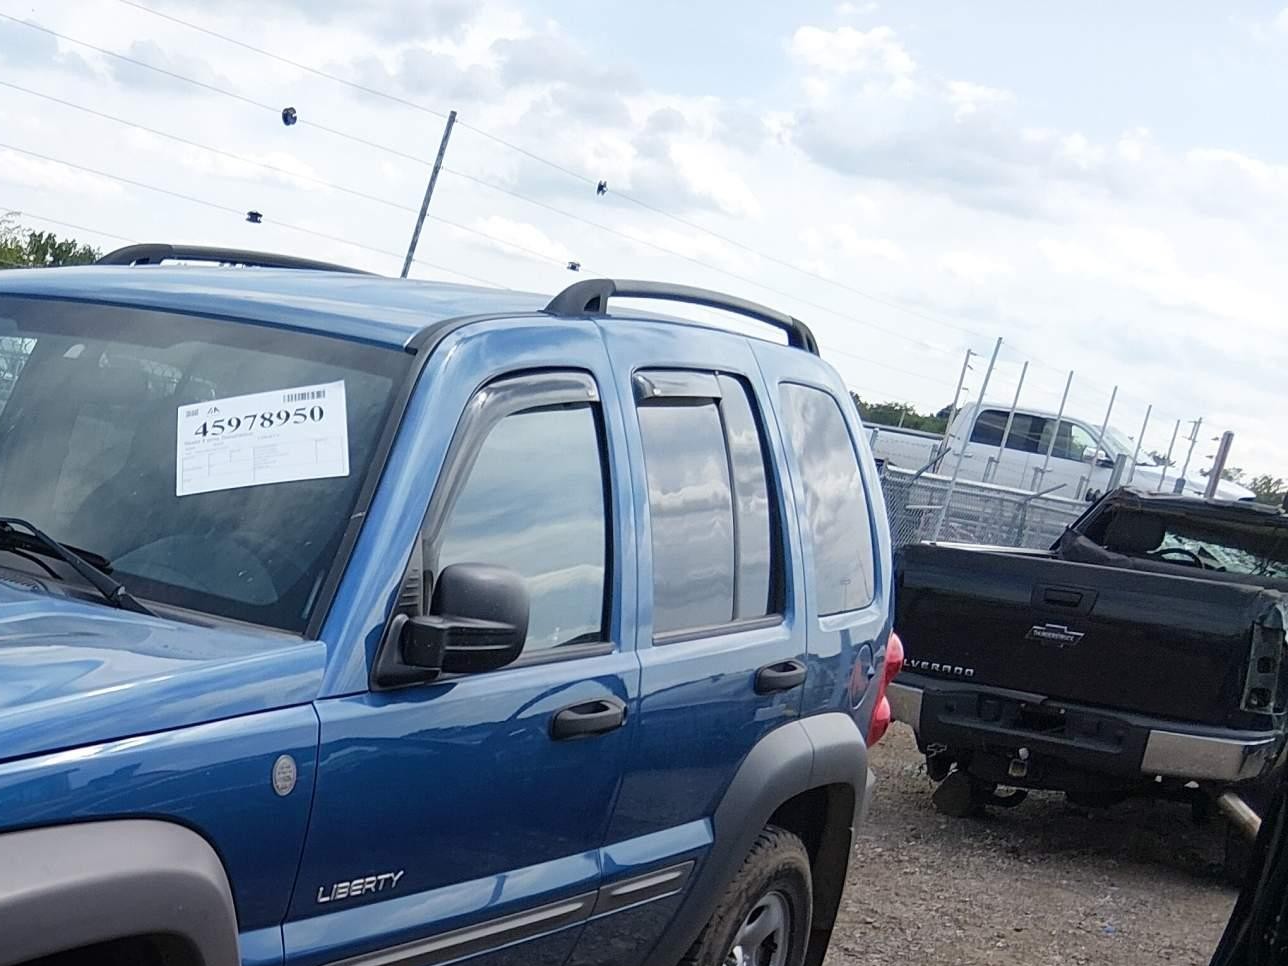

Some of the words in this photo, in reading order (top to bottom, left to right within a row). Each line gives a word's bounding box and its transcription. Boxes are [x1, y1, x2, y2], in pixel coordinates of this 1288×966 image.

[194, 406, 324, 437] 45978950
[903, 659, 974, 676] LVERADO
[317, 870, 404, 903] LIBERTY
